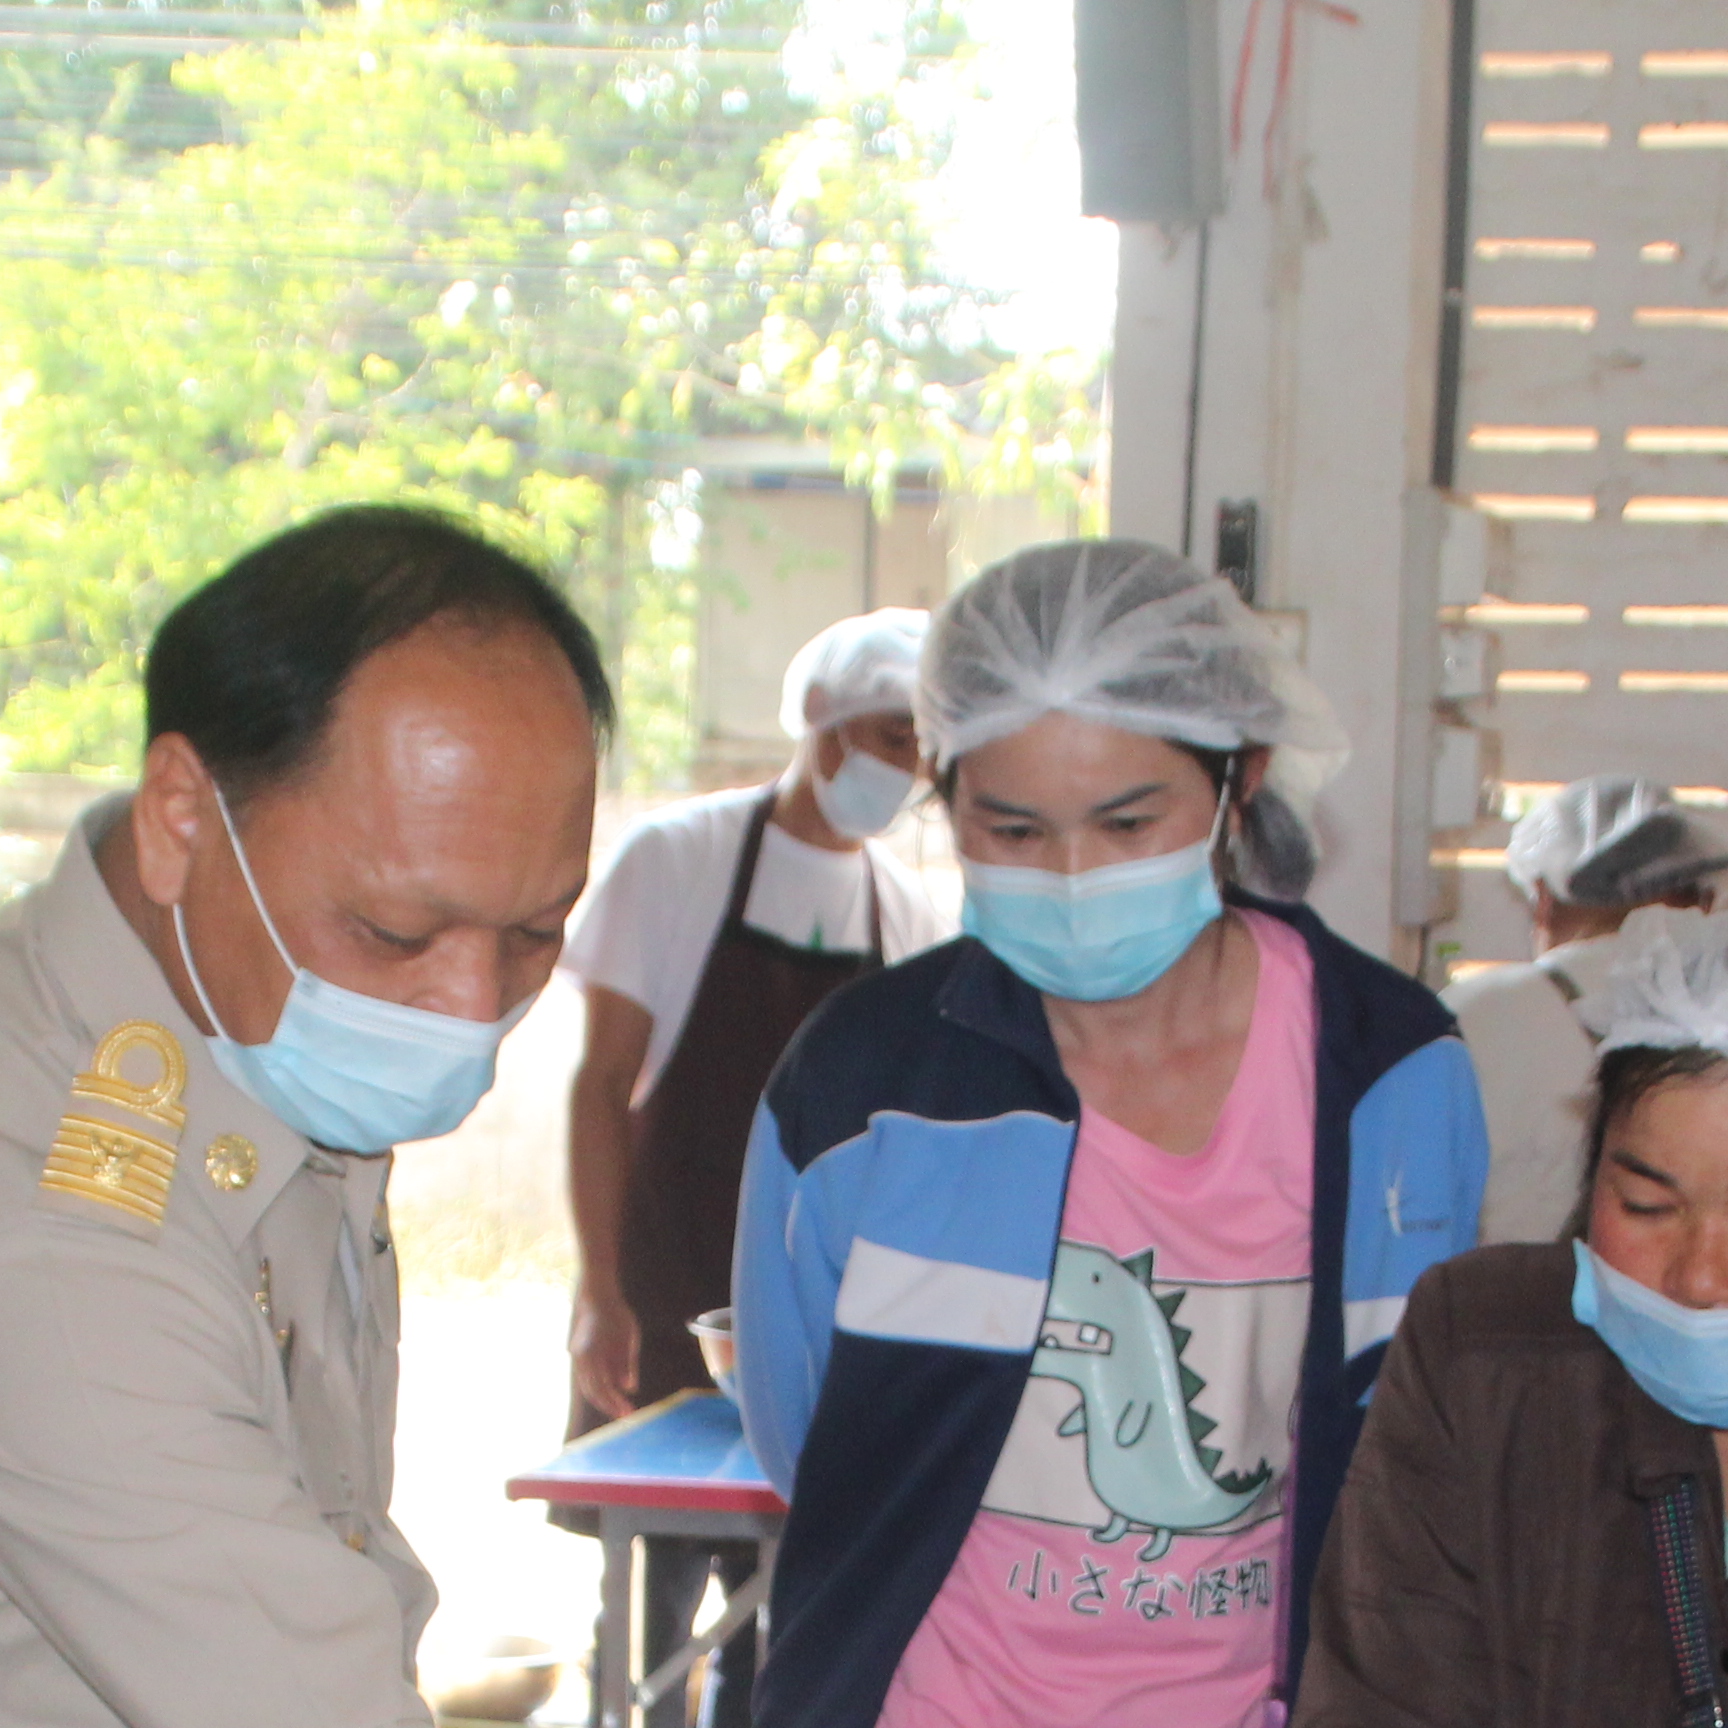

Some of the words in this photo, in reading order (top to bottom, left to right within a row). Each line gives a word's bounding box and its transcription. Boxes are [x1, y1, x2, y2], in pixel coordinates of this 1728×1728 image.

[1006, 1549, 1270, 1620] 小さな怪物
